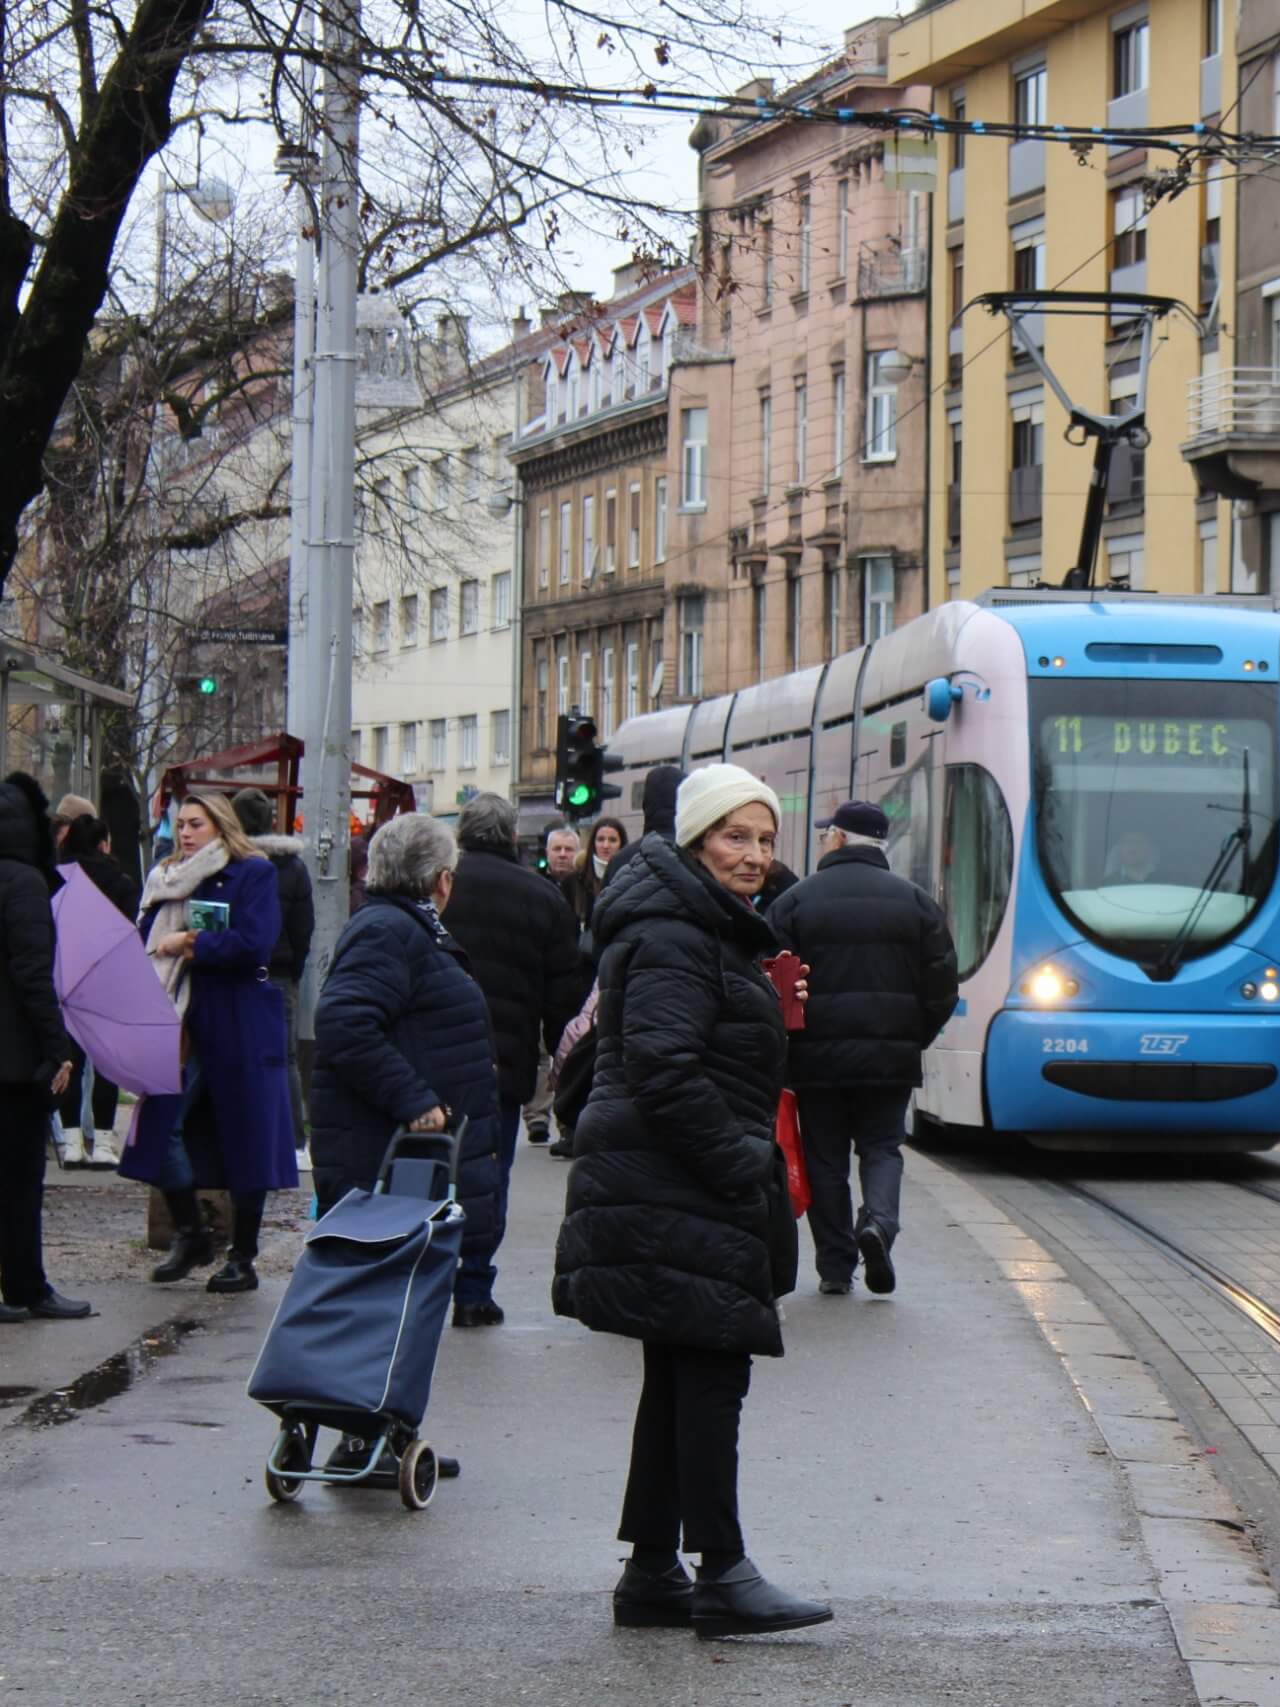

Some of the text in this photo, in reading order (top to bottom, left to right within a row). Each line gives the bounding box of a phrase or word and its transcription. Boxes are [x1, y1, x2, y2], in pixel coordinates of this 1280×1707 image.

[1054, 716, 1229, 755] 11 DUBEC
[1042, 1037, 1089, 1053] 2204
[1139, 1034, 1190, 1055] ZET
